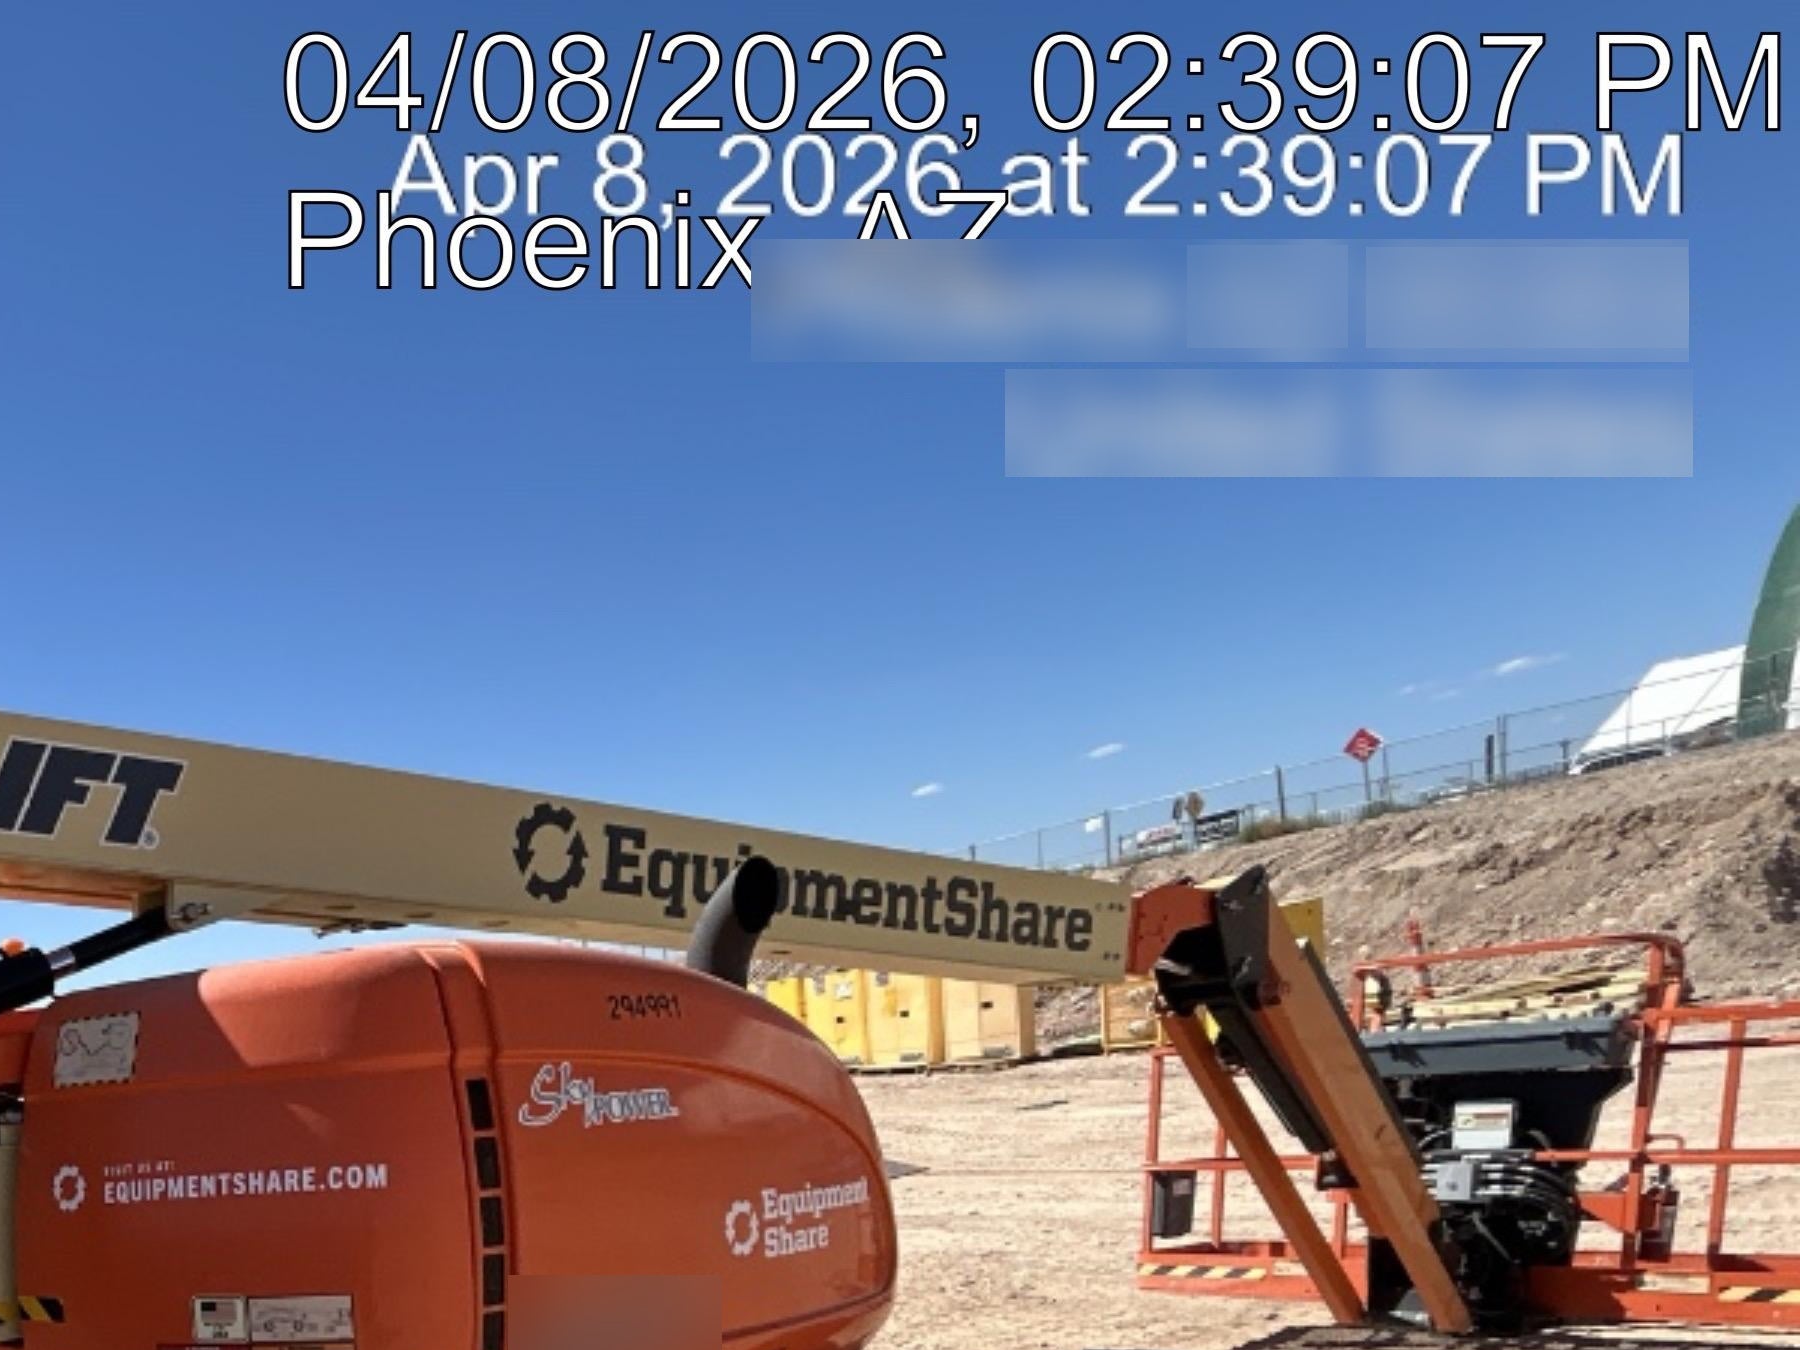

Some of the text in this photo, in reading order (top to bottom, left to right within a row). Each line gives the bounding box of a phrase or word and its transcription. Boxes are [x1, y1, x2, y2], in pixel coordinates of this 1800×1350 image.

[602, 823, 1093, 951] EqumentShare
[104, 1164, 388, 1204] EQUIPMENTSHARE.COM
[761, 1176, 869, 1224] Equipment
[764, 1224, 829, 1258] Share
